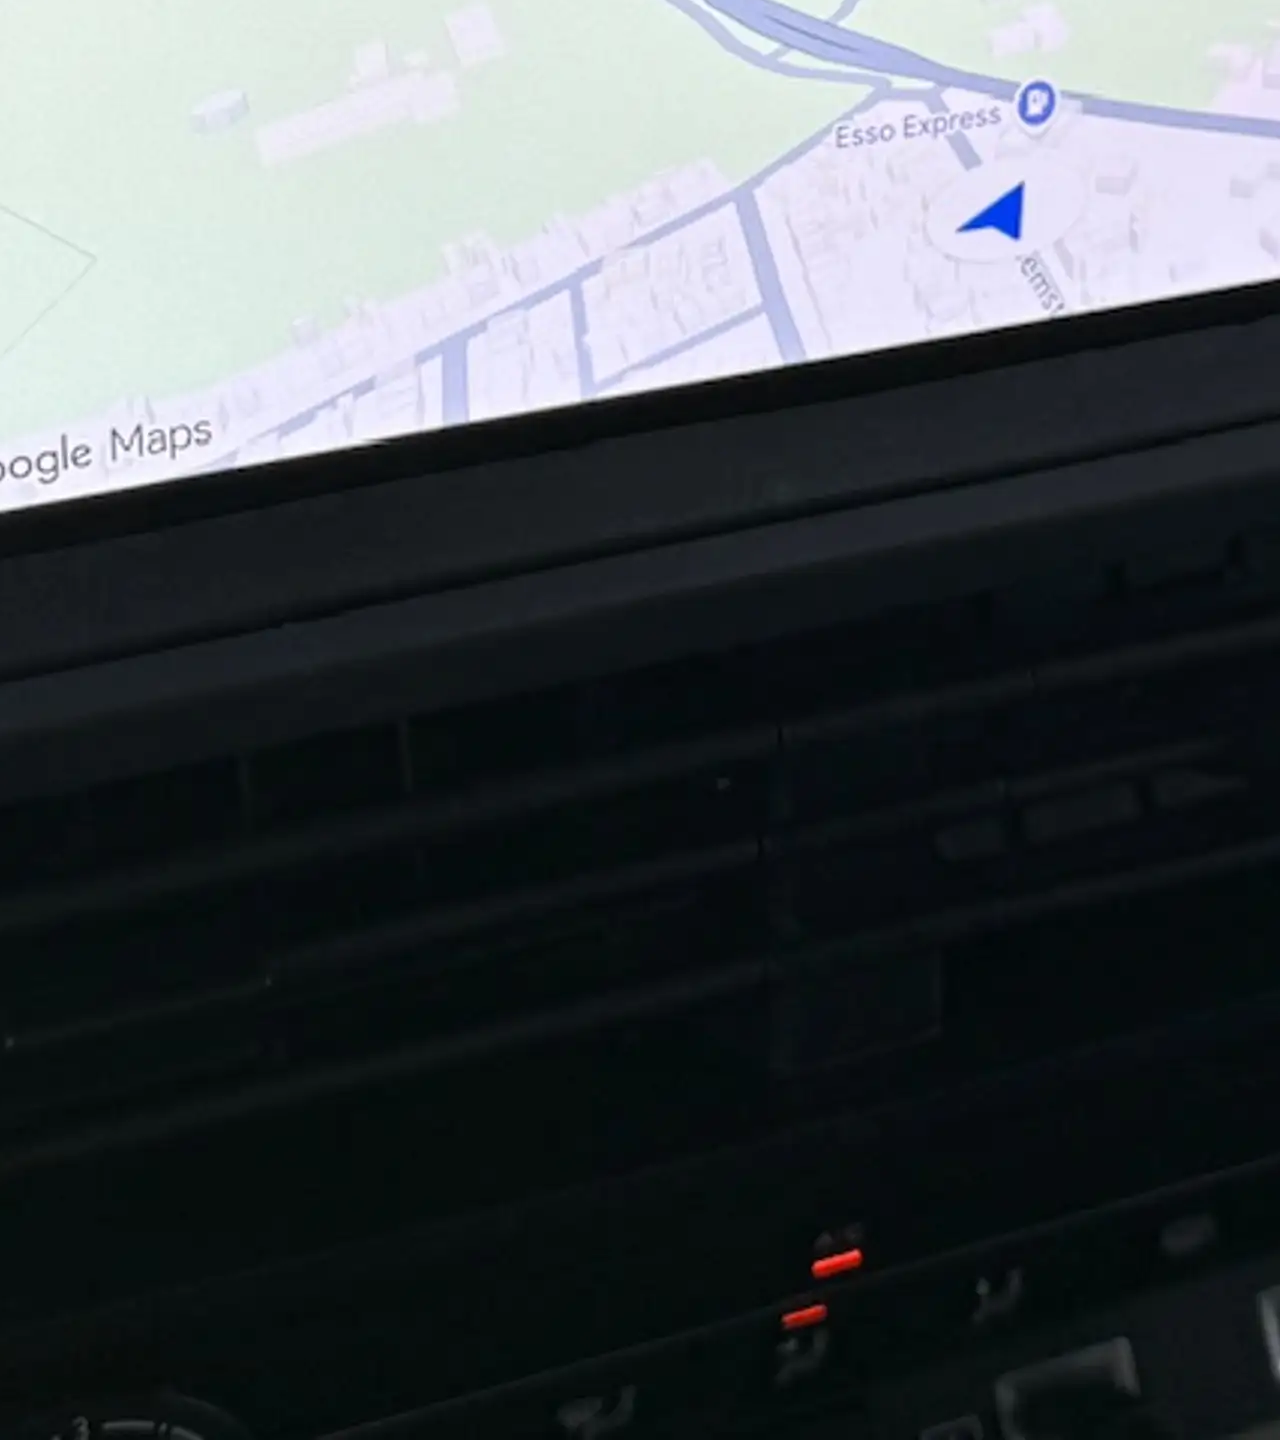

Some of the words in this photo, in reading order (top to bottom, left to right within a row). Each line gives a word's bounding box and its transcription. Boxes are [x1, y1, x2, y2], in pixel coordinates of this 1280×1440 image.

[835, 123, 896, 149] Esso
[903, 106, 1003, 138] Express
[110, 419, 213, 462] Maps
